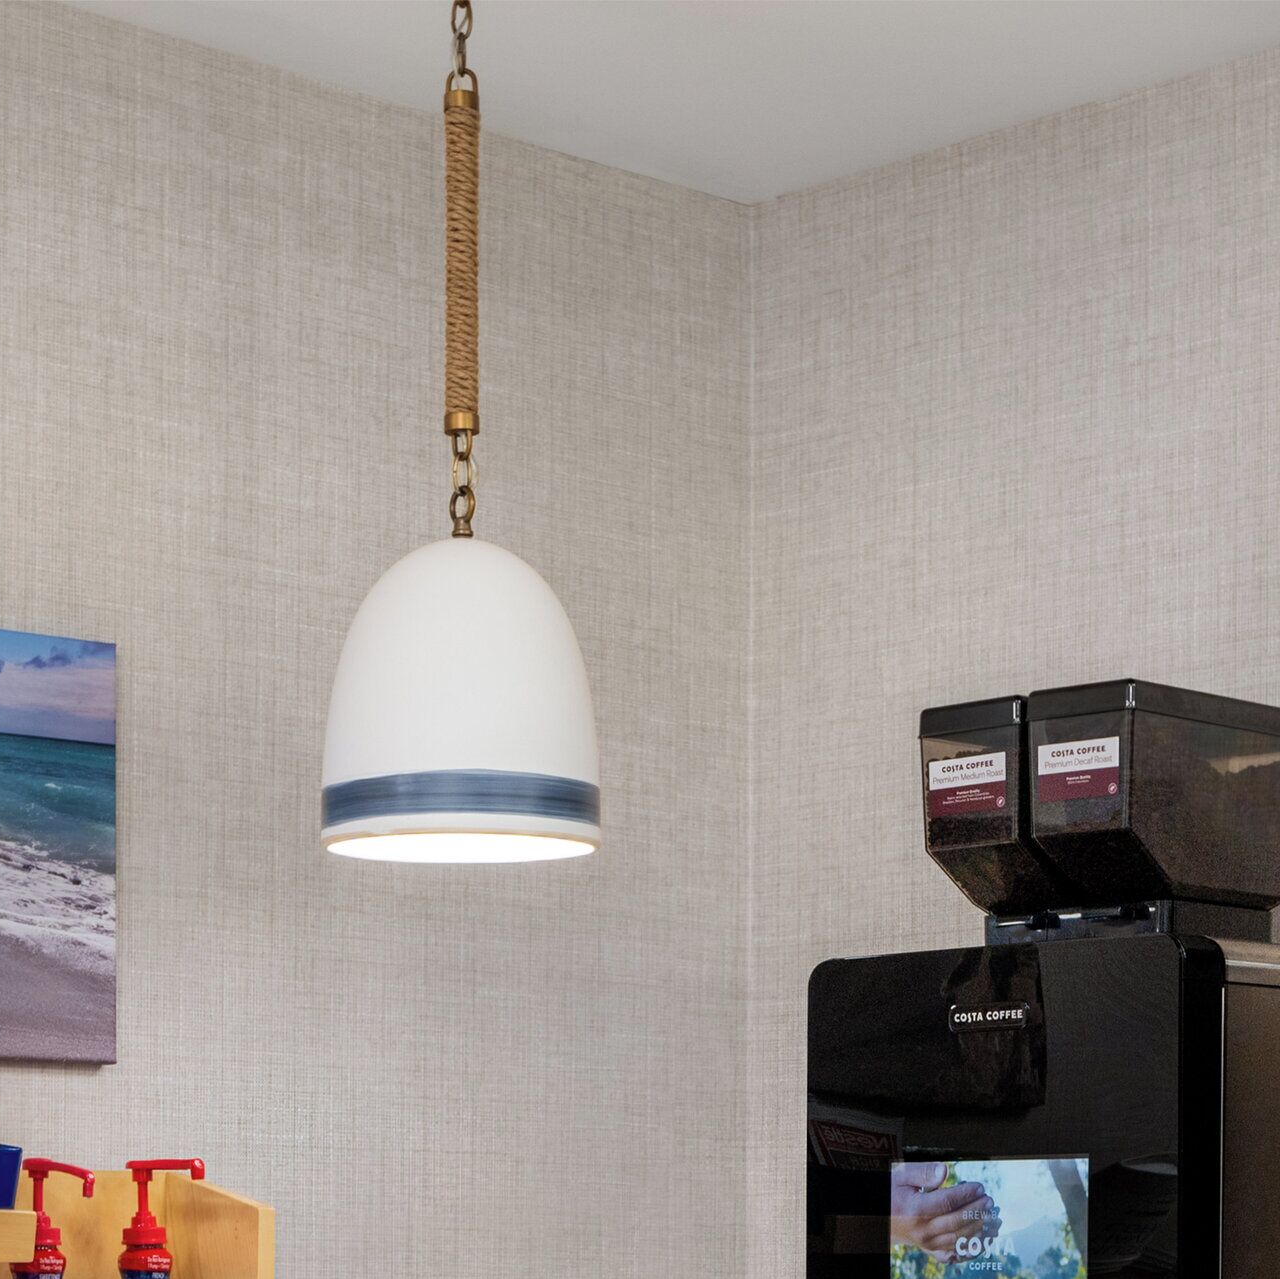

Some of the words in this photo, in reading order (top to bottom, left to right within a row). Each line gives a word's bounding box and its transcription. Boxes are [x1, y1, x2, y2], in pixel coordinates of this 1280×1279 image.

[1051, 749, 1074, 758] COSTA
[1076, 745, 1106, 755] COFFEE
[942, 764, 964, 773] COSTA
[966, 760, 994, 770] COFFEE
[1044, 760, 1073, 769] Premium
[1074, 756, 1094, 767] Decaf
[1094, 756, 1113, 764] Roast
[932, 775, 960, 785] Premium
[960, 772, 986, 781] Medium
[986, 769, 1004, 777] Roast
[954, 1012, 984, 1023] COSTA
[986, 1009, 1023, 1021] COFFEE
[955, 1236, 1017, 1259] COSTA
[968, 1262, 1003, 1271] COFFEE
